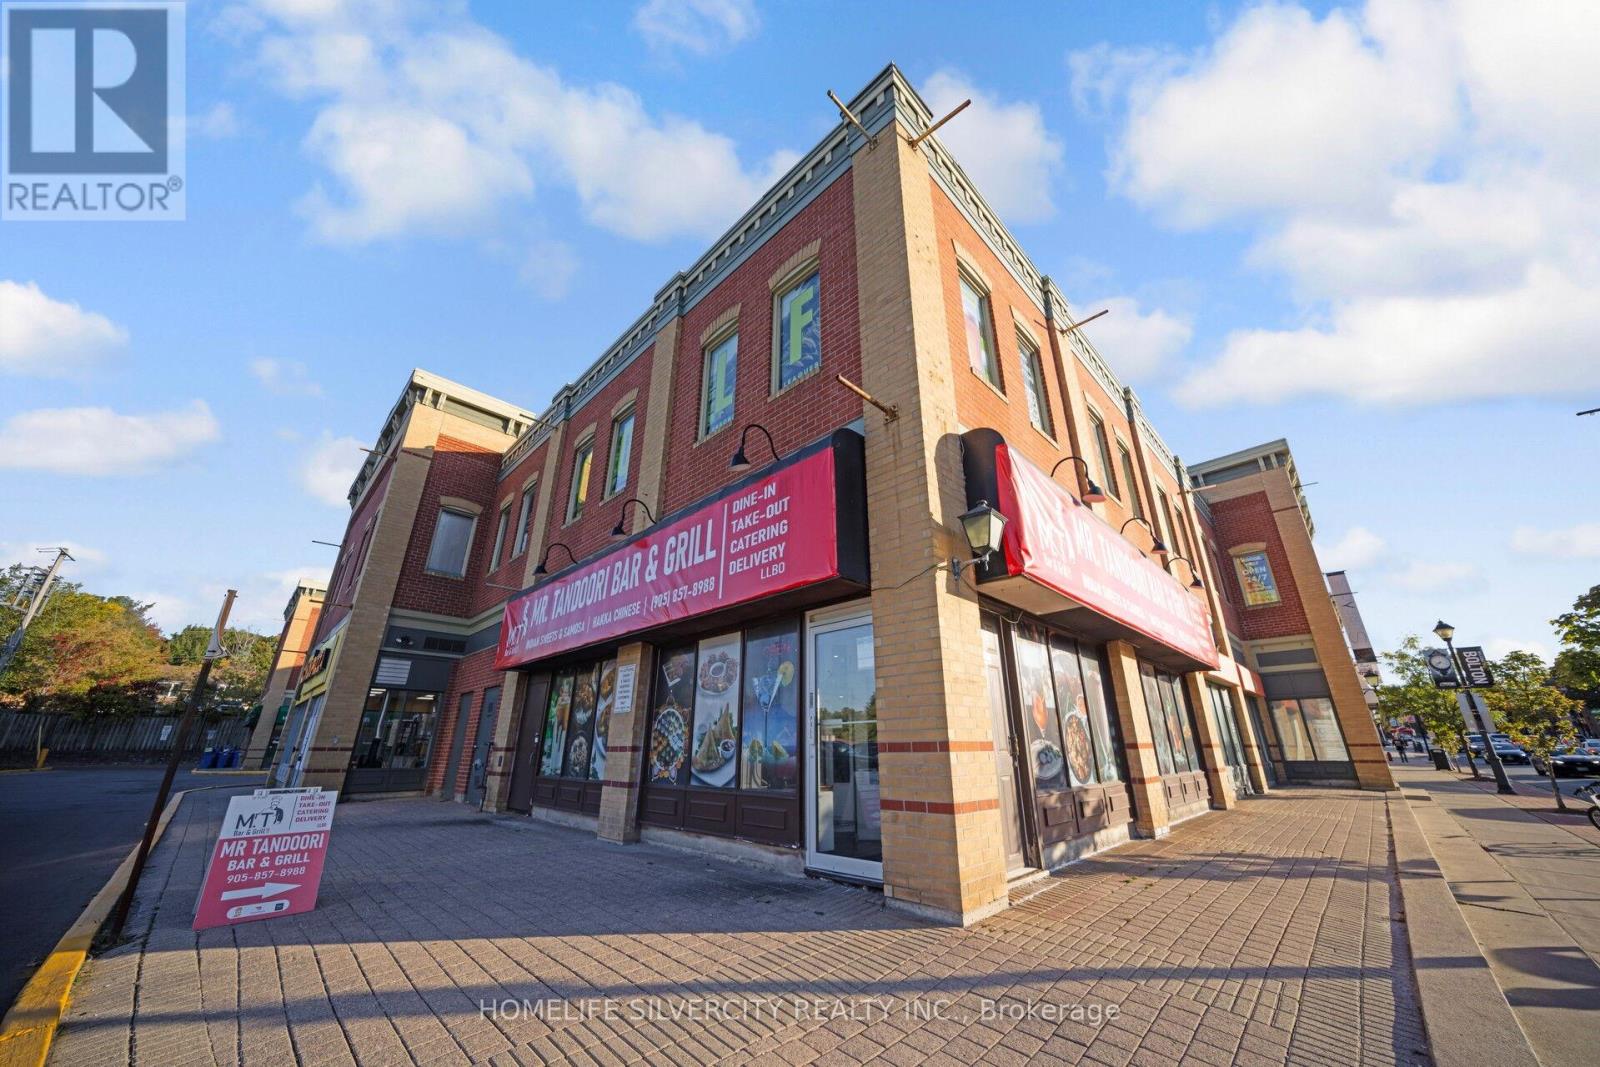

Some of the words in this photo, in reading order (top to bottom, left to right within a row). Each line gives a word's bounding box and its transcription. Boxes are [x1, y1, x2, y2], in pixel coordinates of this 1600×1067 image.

[790, 286, 814, 364] F
[731, 496, 790, 533] TAKE-OUT
[732, 482, 776, 514] DINE-IN
[730, 519, 788, 554] CATERING
[551, 565, 610, 620] TANDOORI
[611, 552, 642, 596] BAR
[645, 544, 658, 582] &
[664, 519, 716, 576] GRILL
[729, 541, 786, 575] DELIVERY
[760, 561, 785, 579] LLBO
[564, 621, 585, 638] SAMOSA
[613, 601, 641, 621] CHINESE
[650, 590, 671, 612] (905)
[672, 576, 715, 603] 857-8988
[1463, 651, 1489, 684] BOLTON
[295, 815, 327, 823] DELIVERY
[220, 840, 247, 858] MR
[252, 833, 325, 855] TANDOORI
[227, 858, 256, 871] BAR
[260, 857, 270, 868] &
[275, 852, 310, 866] GRILL
[226, 866, 305, 884] 905-857-8988
